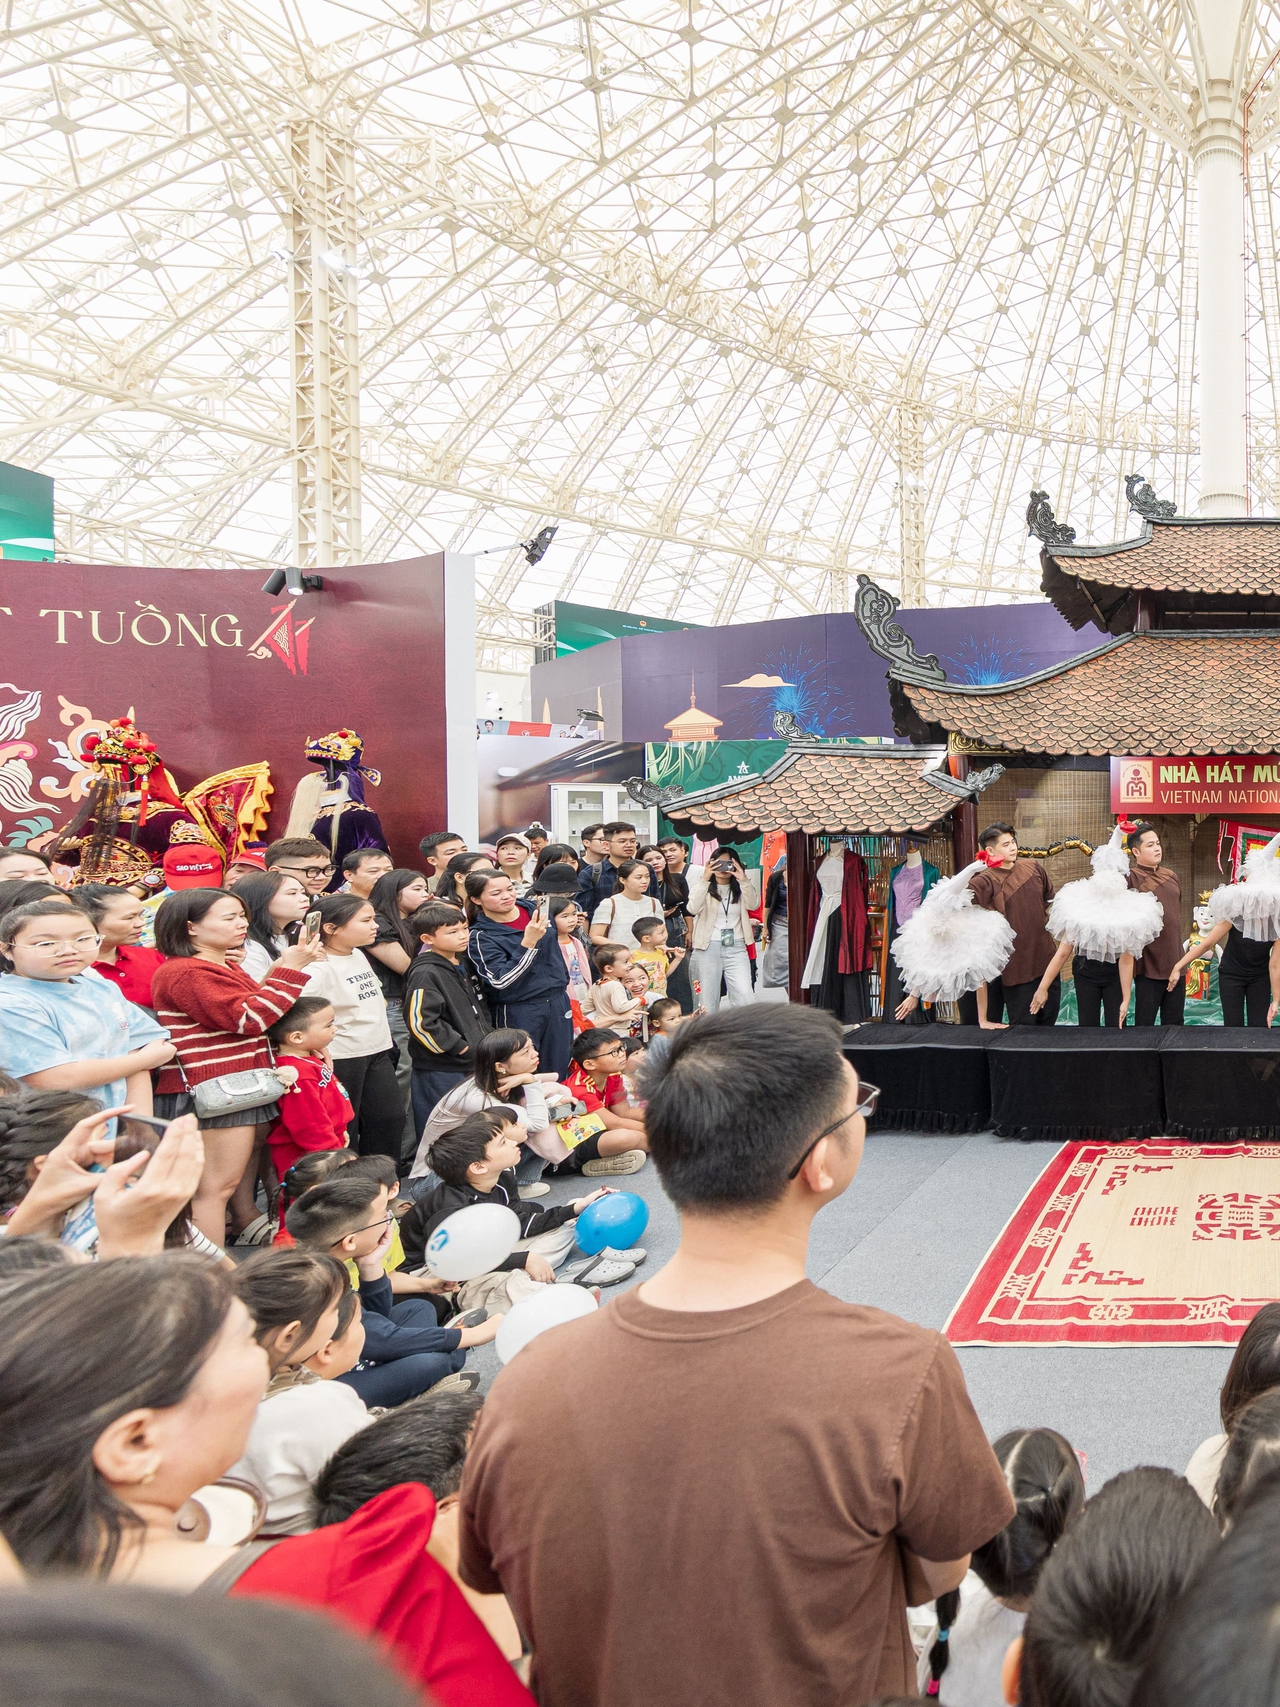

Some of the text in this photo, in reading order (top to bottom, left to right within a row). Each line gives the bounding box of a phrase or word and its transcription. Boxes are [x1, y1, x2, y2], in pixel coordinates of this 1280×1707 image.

[39, 600, 244, 647] TUỒNG
[1160, 761, 1200, 784] NHÀ
[1206, 761, 1245, 783] HÁT
[1160, 790, 1222, 804] VIETNAM
[360, 981, 375, 990] ONE
